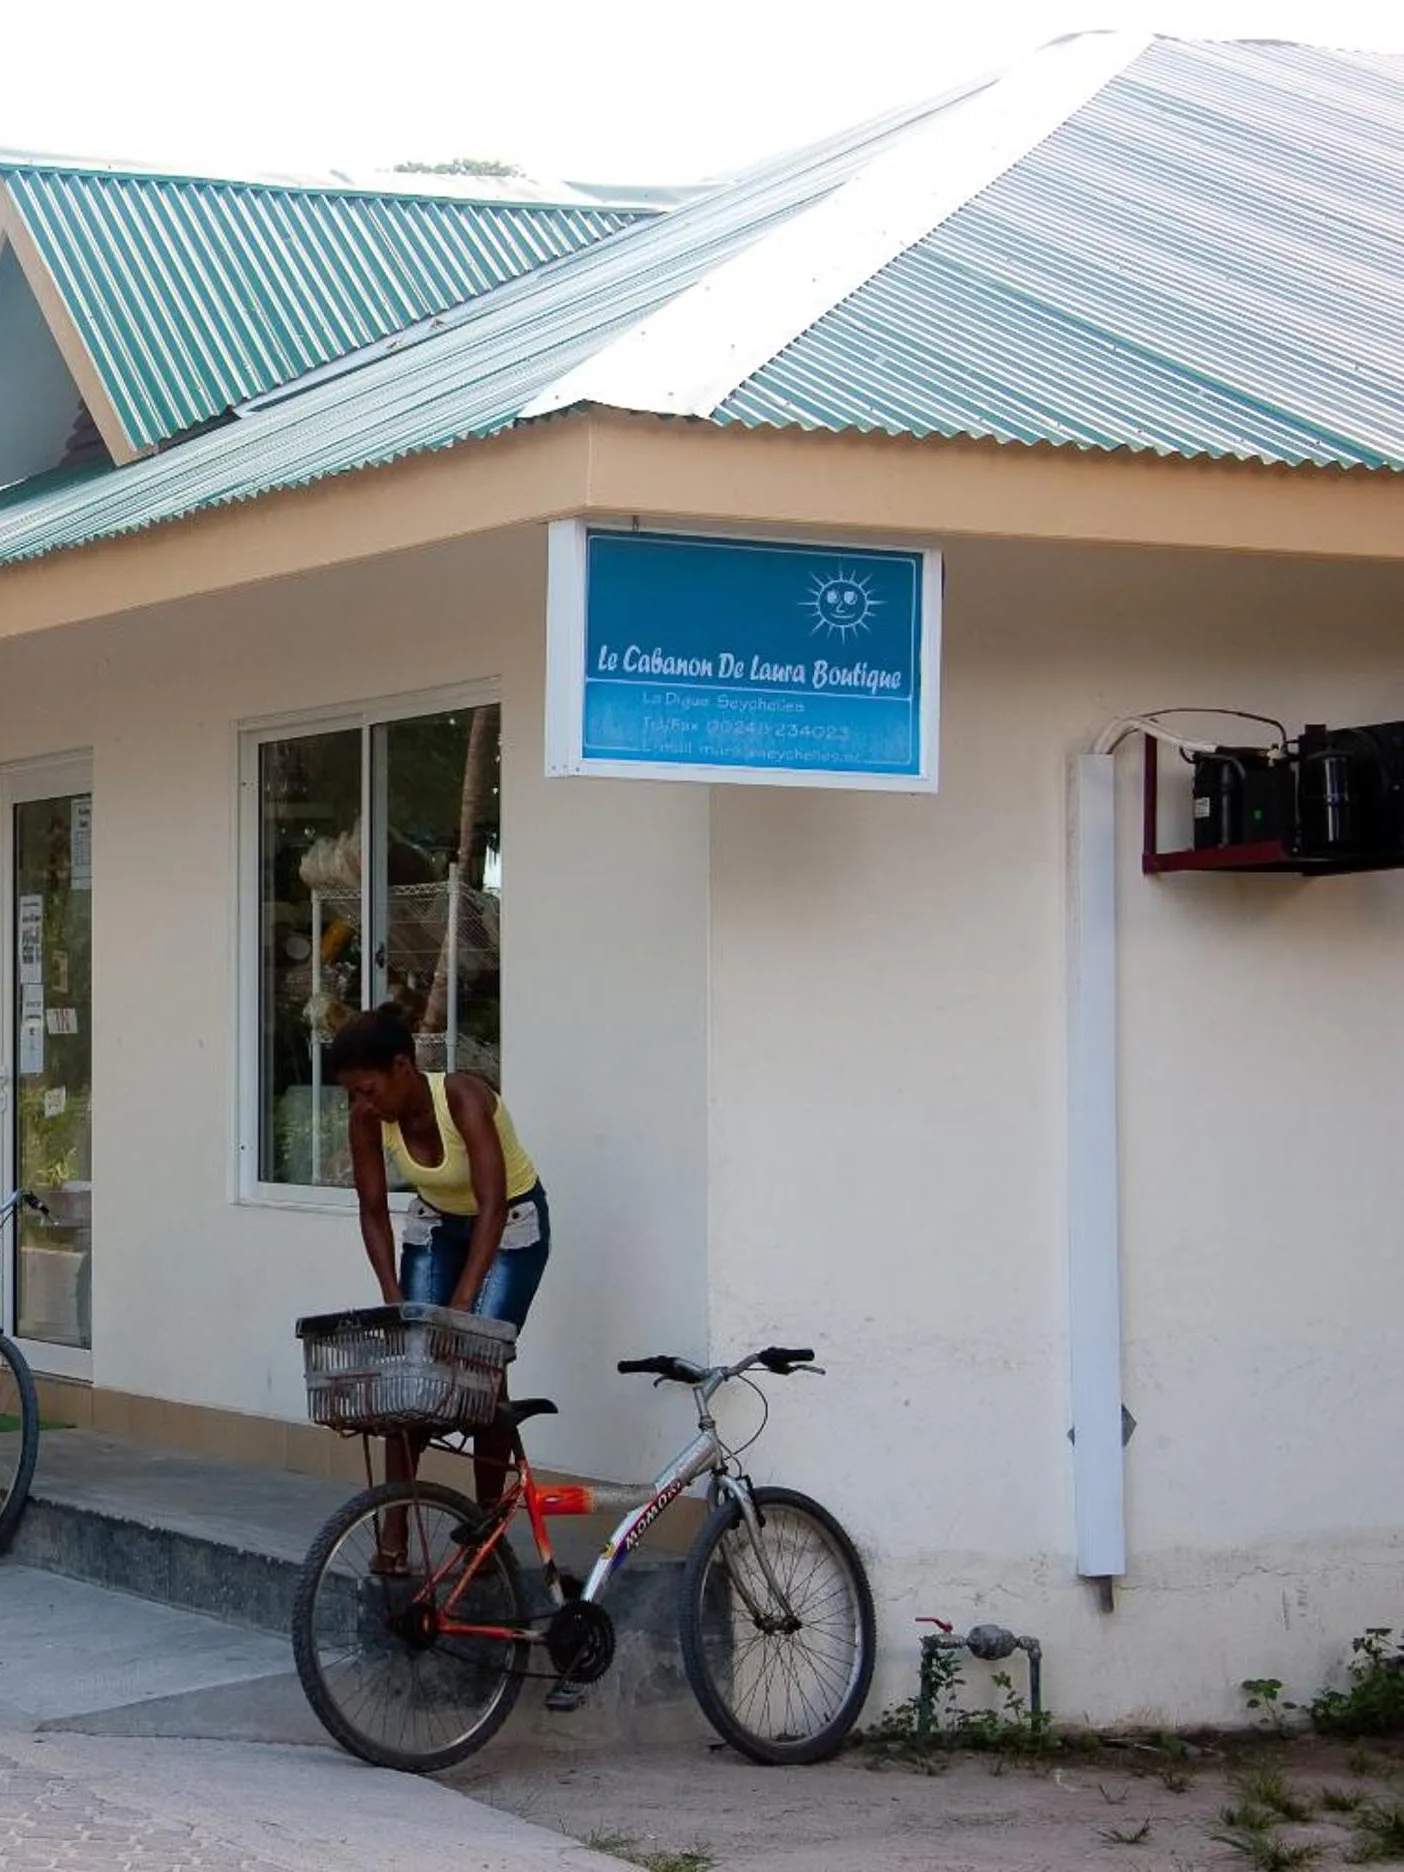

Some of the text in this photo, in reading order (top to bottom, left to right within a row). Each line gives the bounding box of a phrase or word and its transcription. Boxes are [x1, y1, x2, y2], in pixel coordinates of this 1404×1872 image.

[598, 644, 902, 695] Le Cabanon De Laura Boutique
